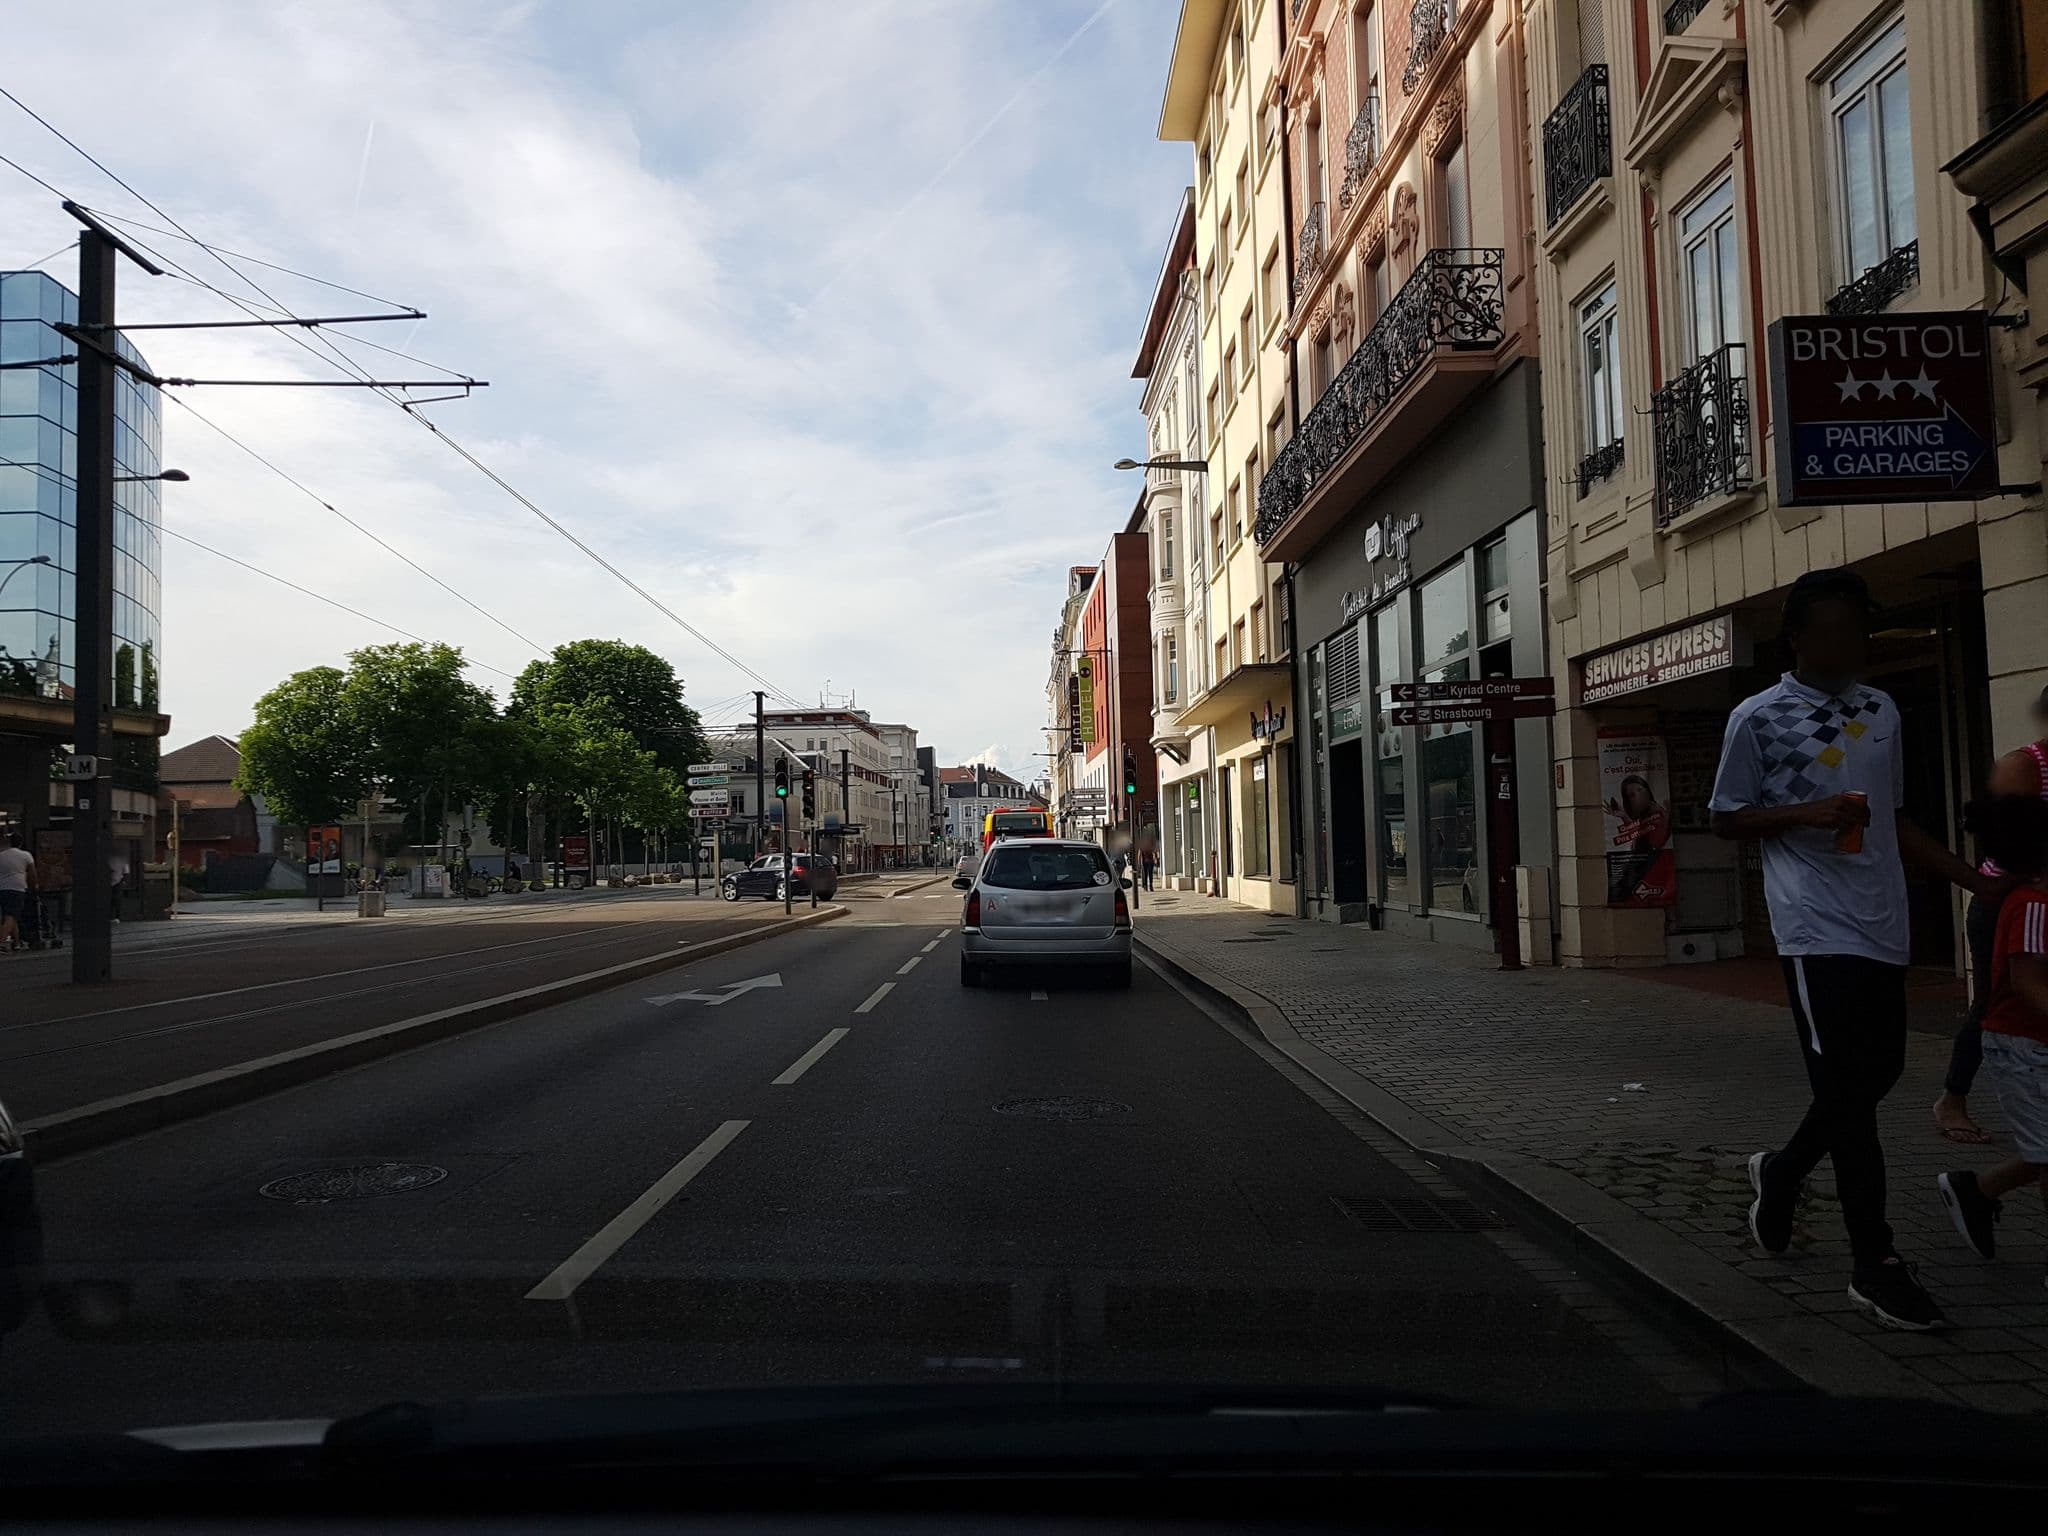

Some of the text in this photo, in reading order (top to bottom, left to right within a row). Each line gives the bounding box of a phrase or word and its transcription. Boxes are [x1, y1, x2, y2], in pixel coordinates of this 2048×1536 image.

[1791, 325, 1981, 362] BRISTOL
[1825, 424, 1944, 449] PARKING
[1805, 450, 1970, 476] & GARAGES
[1585, 617, 1726, 687] SERVICES EXPRESS
[1583, 674, 1649, 702] CORDONNERIE
[1658, 650, 1730, 682] SERRURERIE
[1450, 684, 1521, 699] Kyriad Centre
[1082, 684, 1094, 736] HOTEL
[1433, 707, 1492, 721] Strasbourg
[1604, 766, 1623, 774] c'est
[988, 900, 996, 910] A
